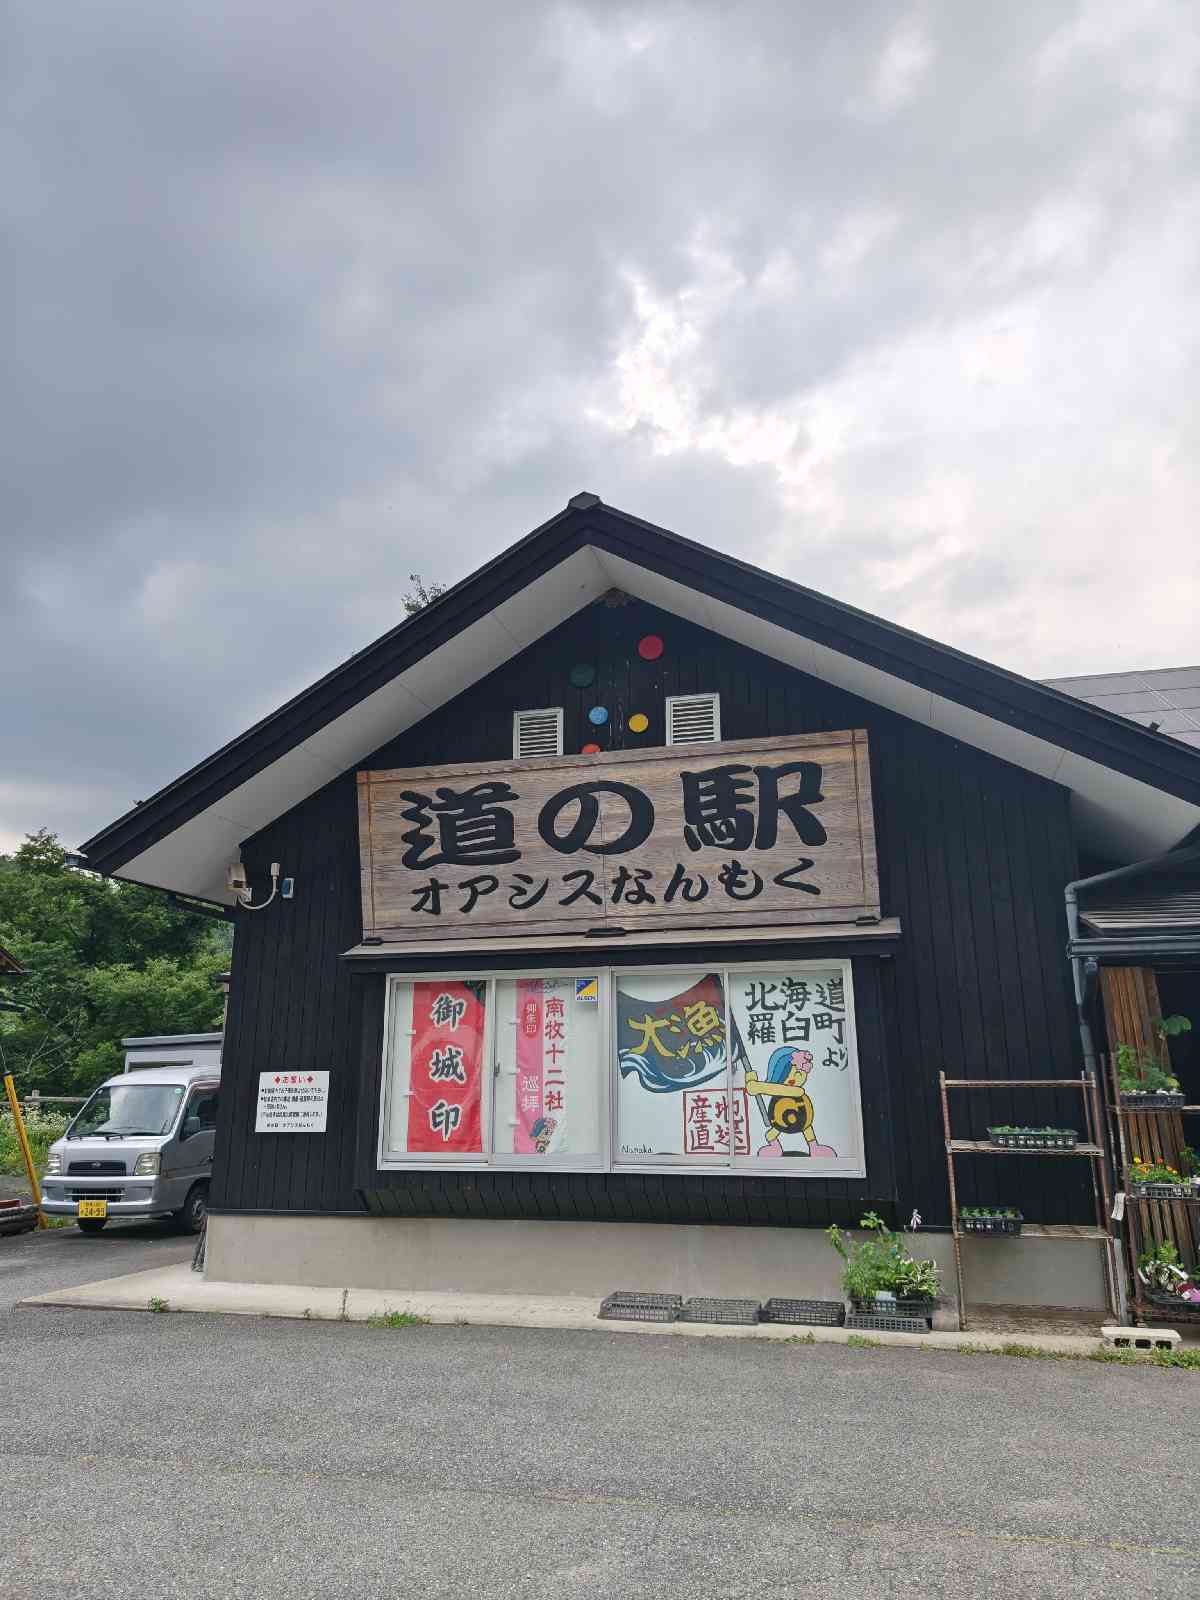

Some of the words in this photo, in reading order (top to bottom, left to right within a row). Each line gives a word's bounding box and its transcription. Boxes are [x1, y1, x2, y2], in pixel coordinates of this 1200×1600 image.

[400, 761, 828, 871] 道の駅
[410, 858, 822, 915] オアシスなんもく
[745, 977, 845, 1012] 北海道
[544, 997, 565, 1112] 南牧十二社
[625, 1000, 728, 1060] 大漁
[747, 1012, 845, 1046] 羅臼町
[427, 993, 466, 1142] 御城印
